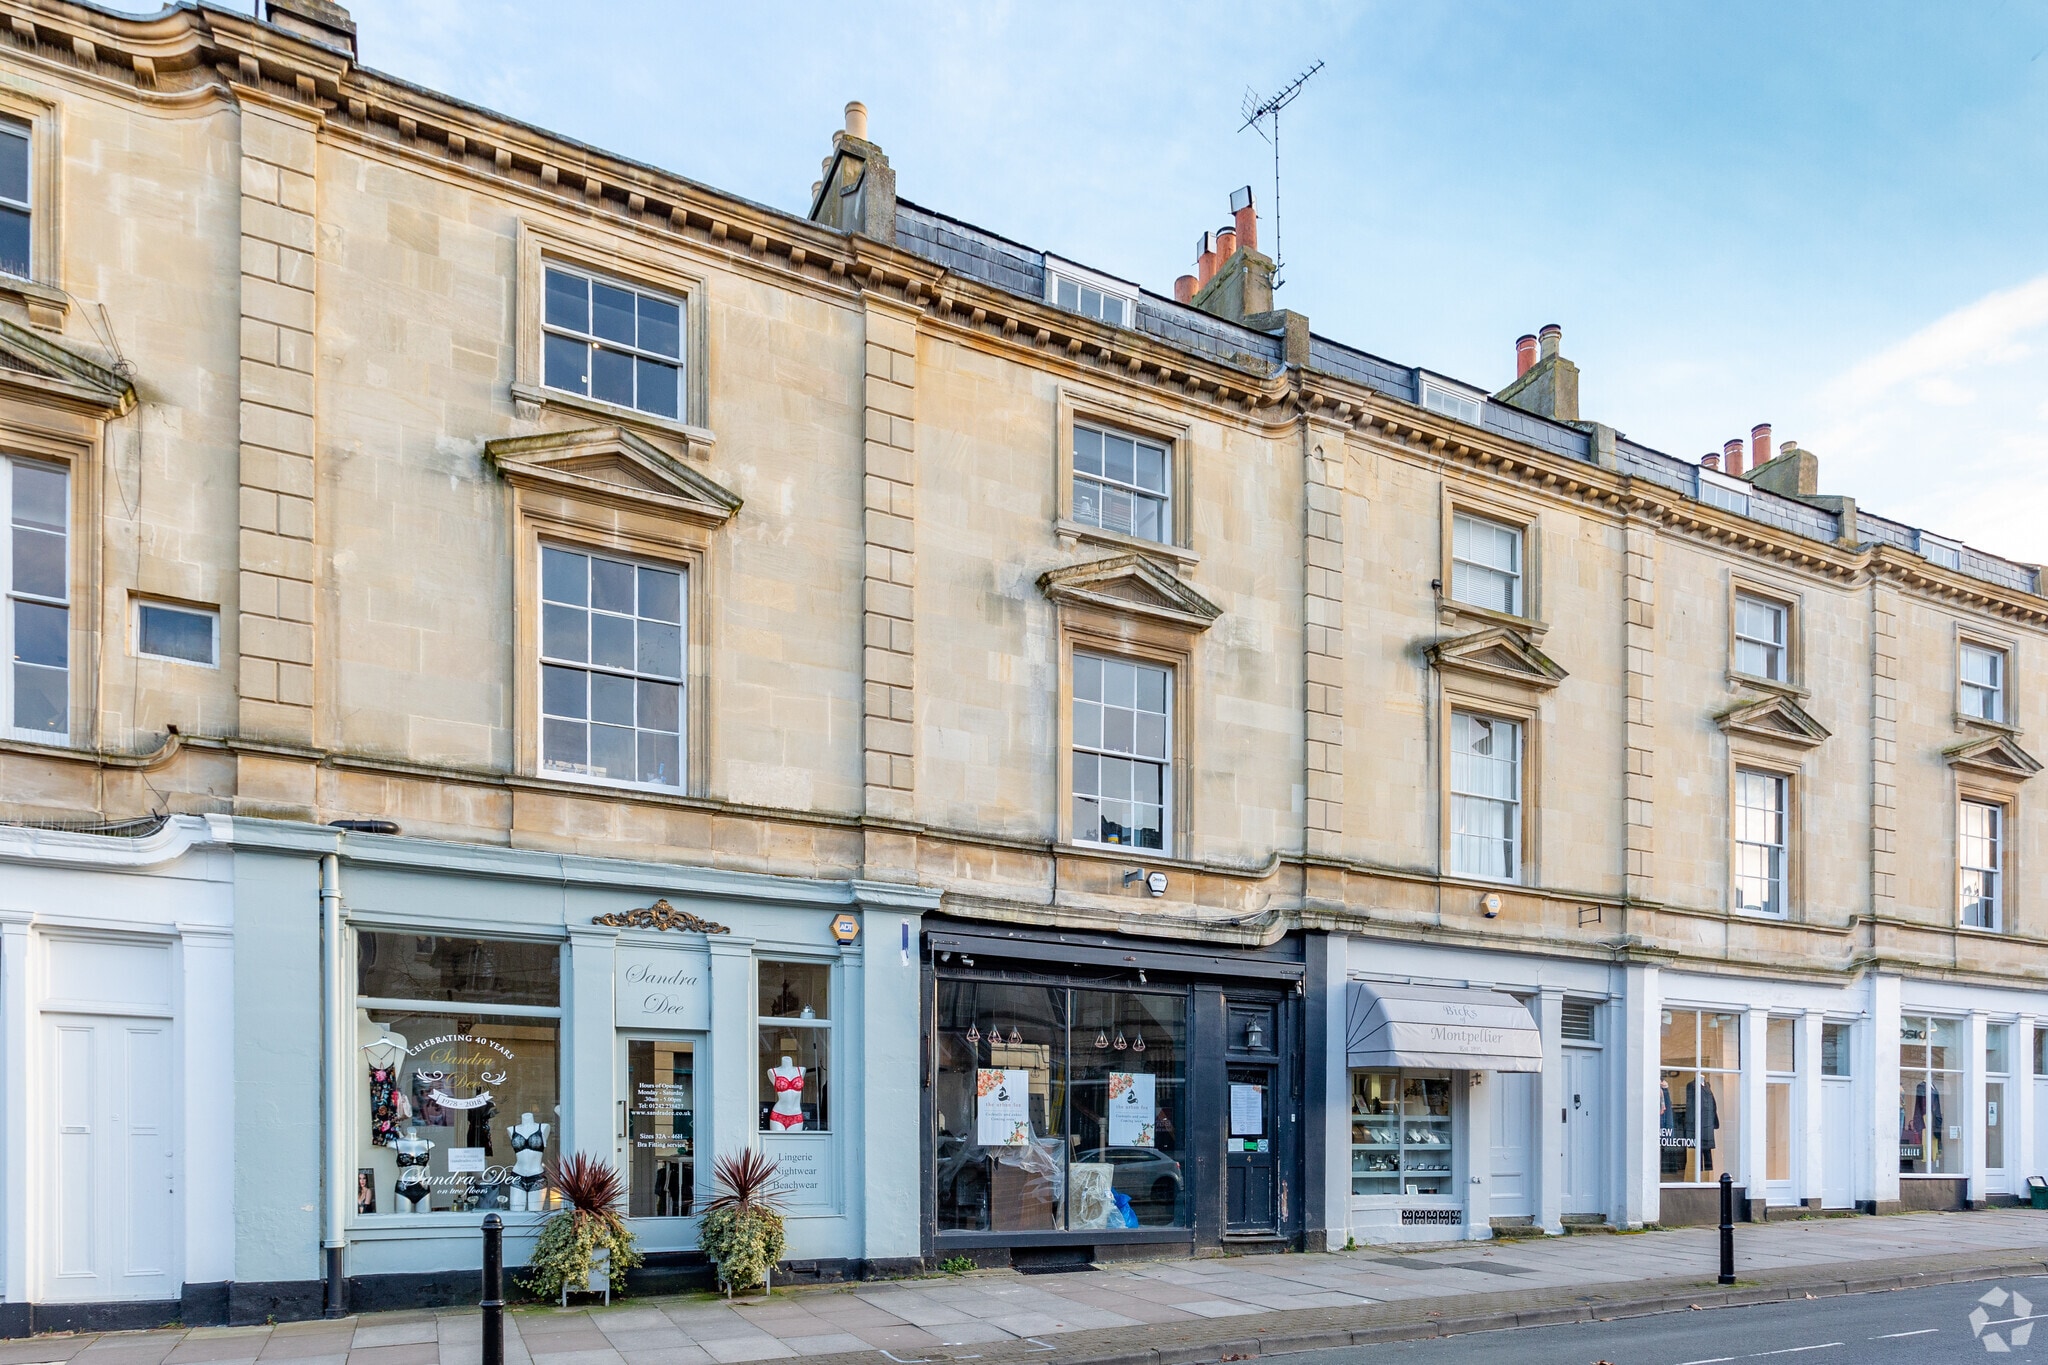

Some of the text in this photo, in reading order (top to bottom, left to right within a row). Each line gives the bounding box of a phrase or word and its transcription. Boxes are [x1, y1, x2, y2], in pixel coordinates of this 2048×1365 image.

[840, 923, 852, 931] ADT
[626, 962, 698, 986] Sandra
[642, 993, 684, 1014] Dee
[1431, 1027, 1503, 1044] Montpellier
[409, 1034, 515, 1060] CELEBRATING 40 YEARS
[430, 1047, 493, 1065] Sandra
[445, 1071, 482, 1089] Dee
[441, 1098, 458, 1106] 1978
[465, 1099, 482, 1107] 2018
[1659, 1138, 1697, 1147] OLLECTION
[778, 1152, 813, 1163] Lingerie
[1246, 1155, 1252, 1163] 4
[401, 1165, 521, 1187] Sandra Dee
[774, 1166, 817, 1177] Nightwear
[773, 1180, 818, 1189] Beachwear
[461, 1186, 488, 1197] floors
